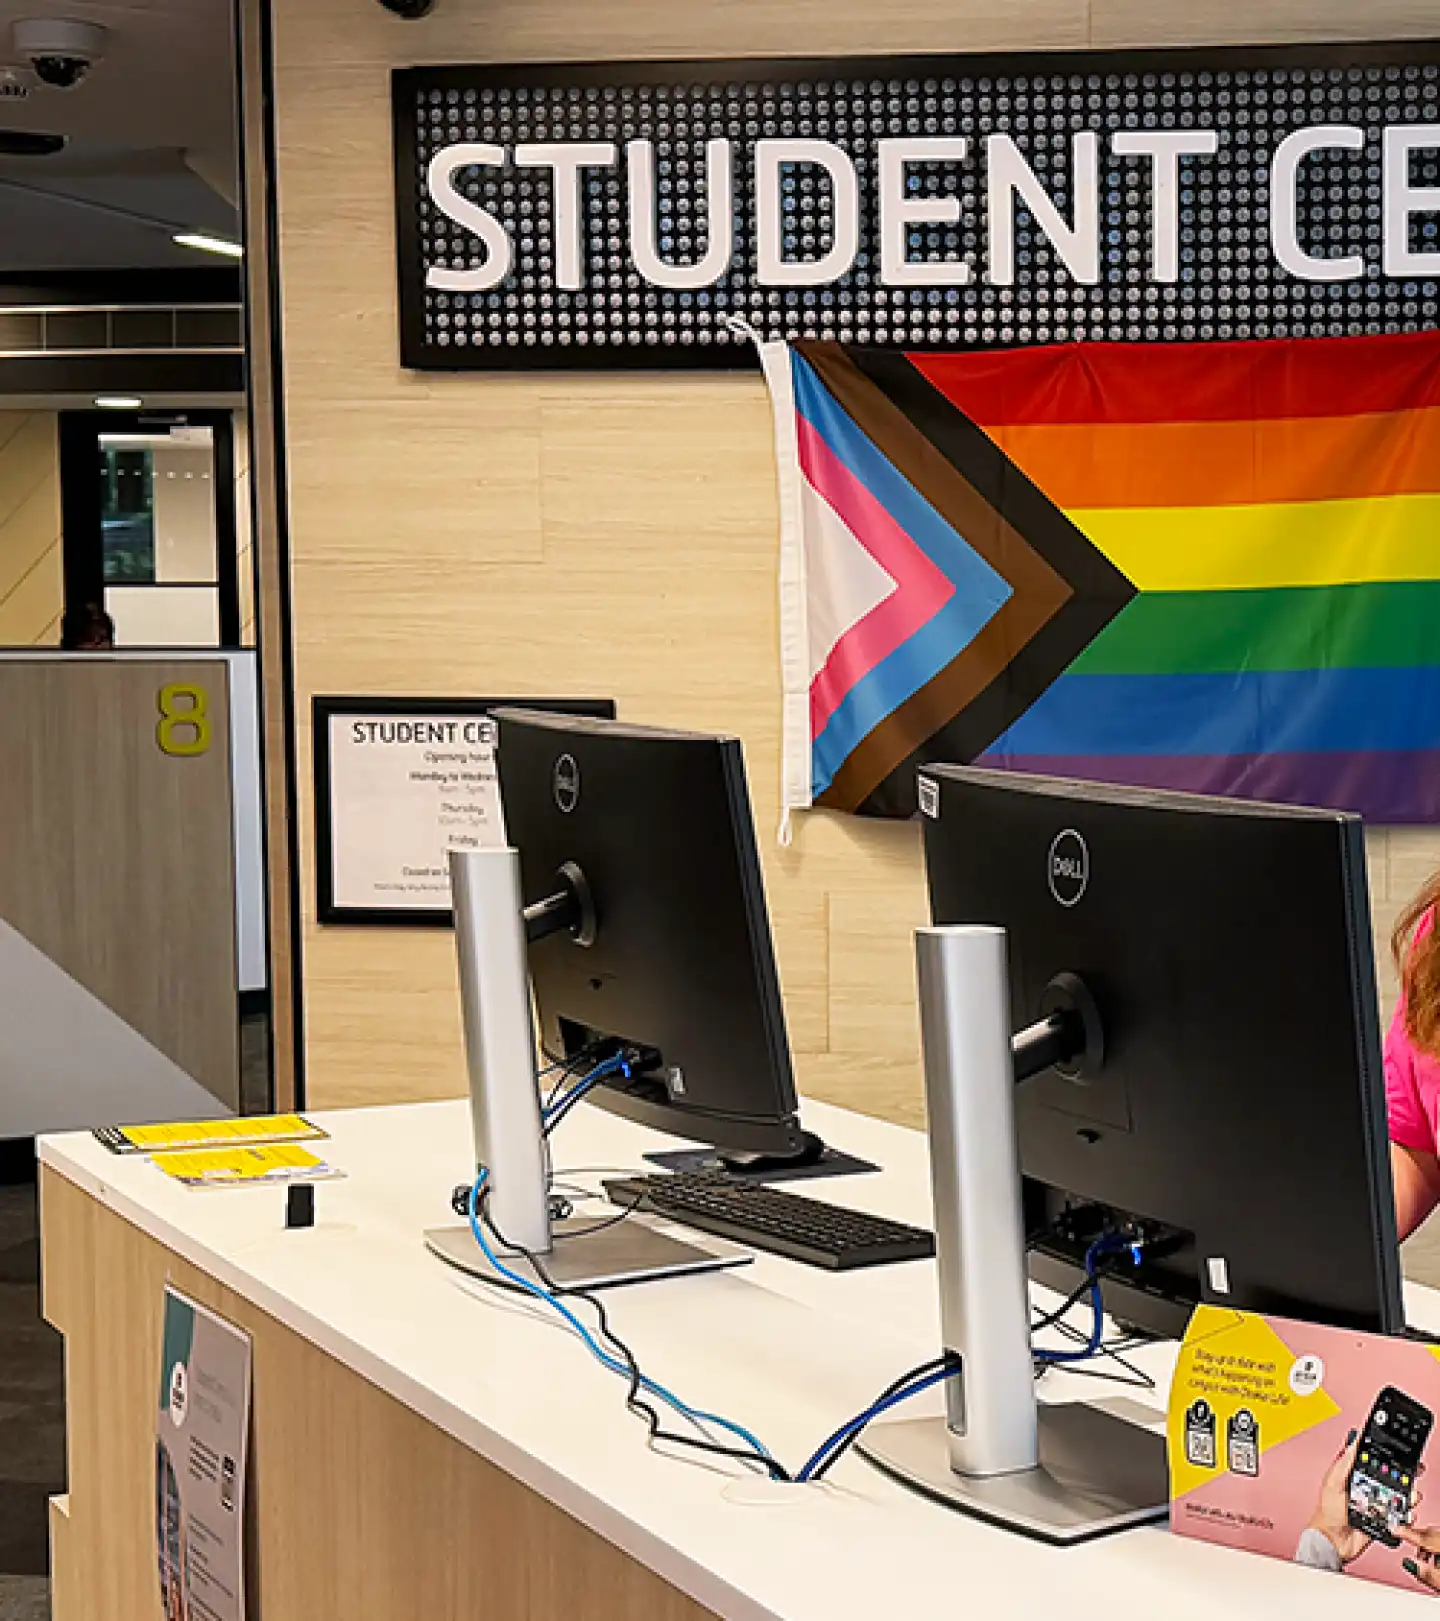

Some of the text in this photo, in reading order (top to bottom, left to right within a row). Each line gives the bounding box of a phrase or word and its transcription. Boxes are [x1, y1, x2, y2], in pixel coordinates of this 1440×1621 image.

[425, 131, 1217, 291] STUDENT
[157, 682, 211, 756] 8
[353, 722, 458, 743] STUDENT
